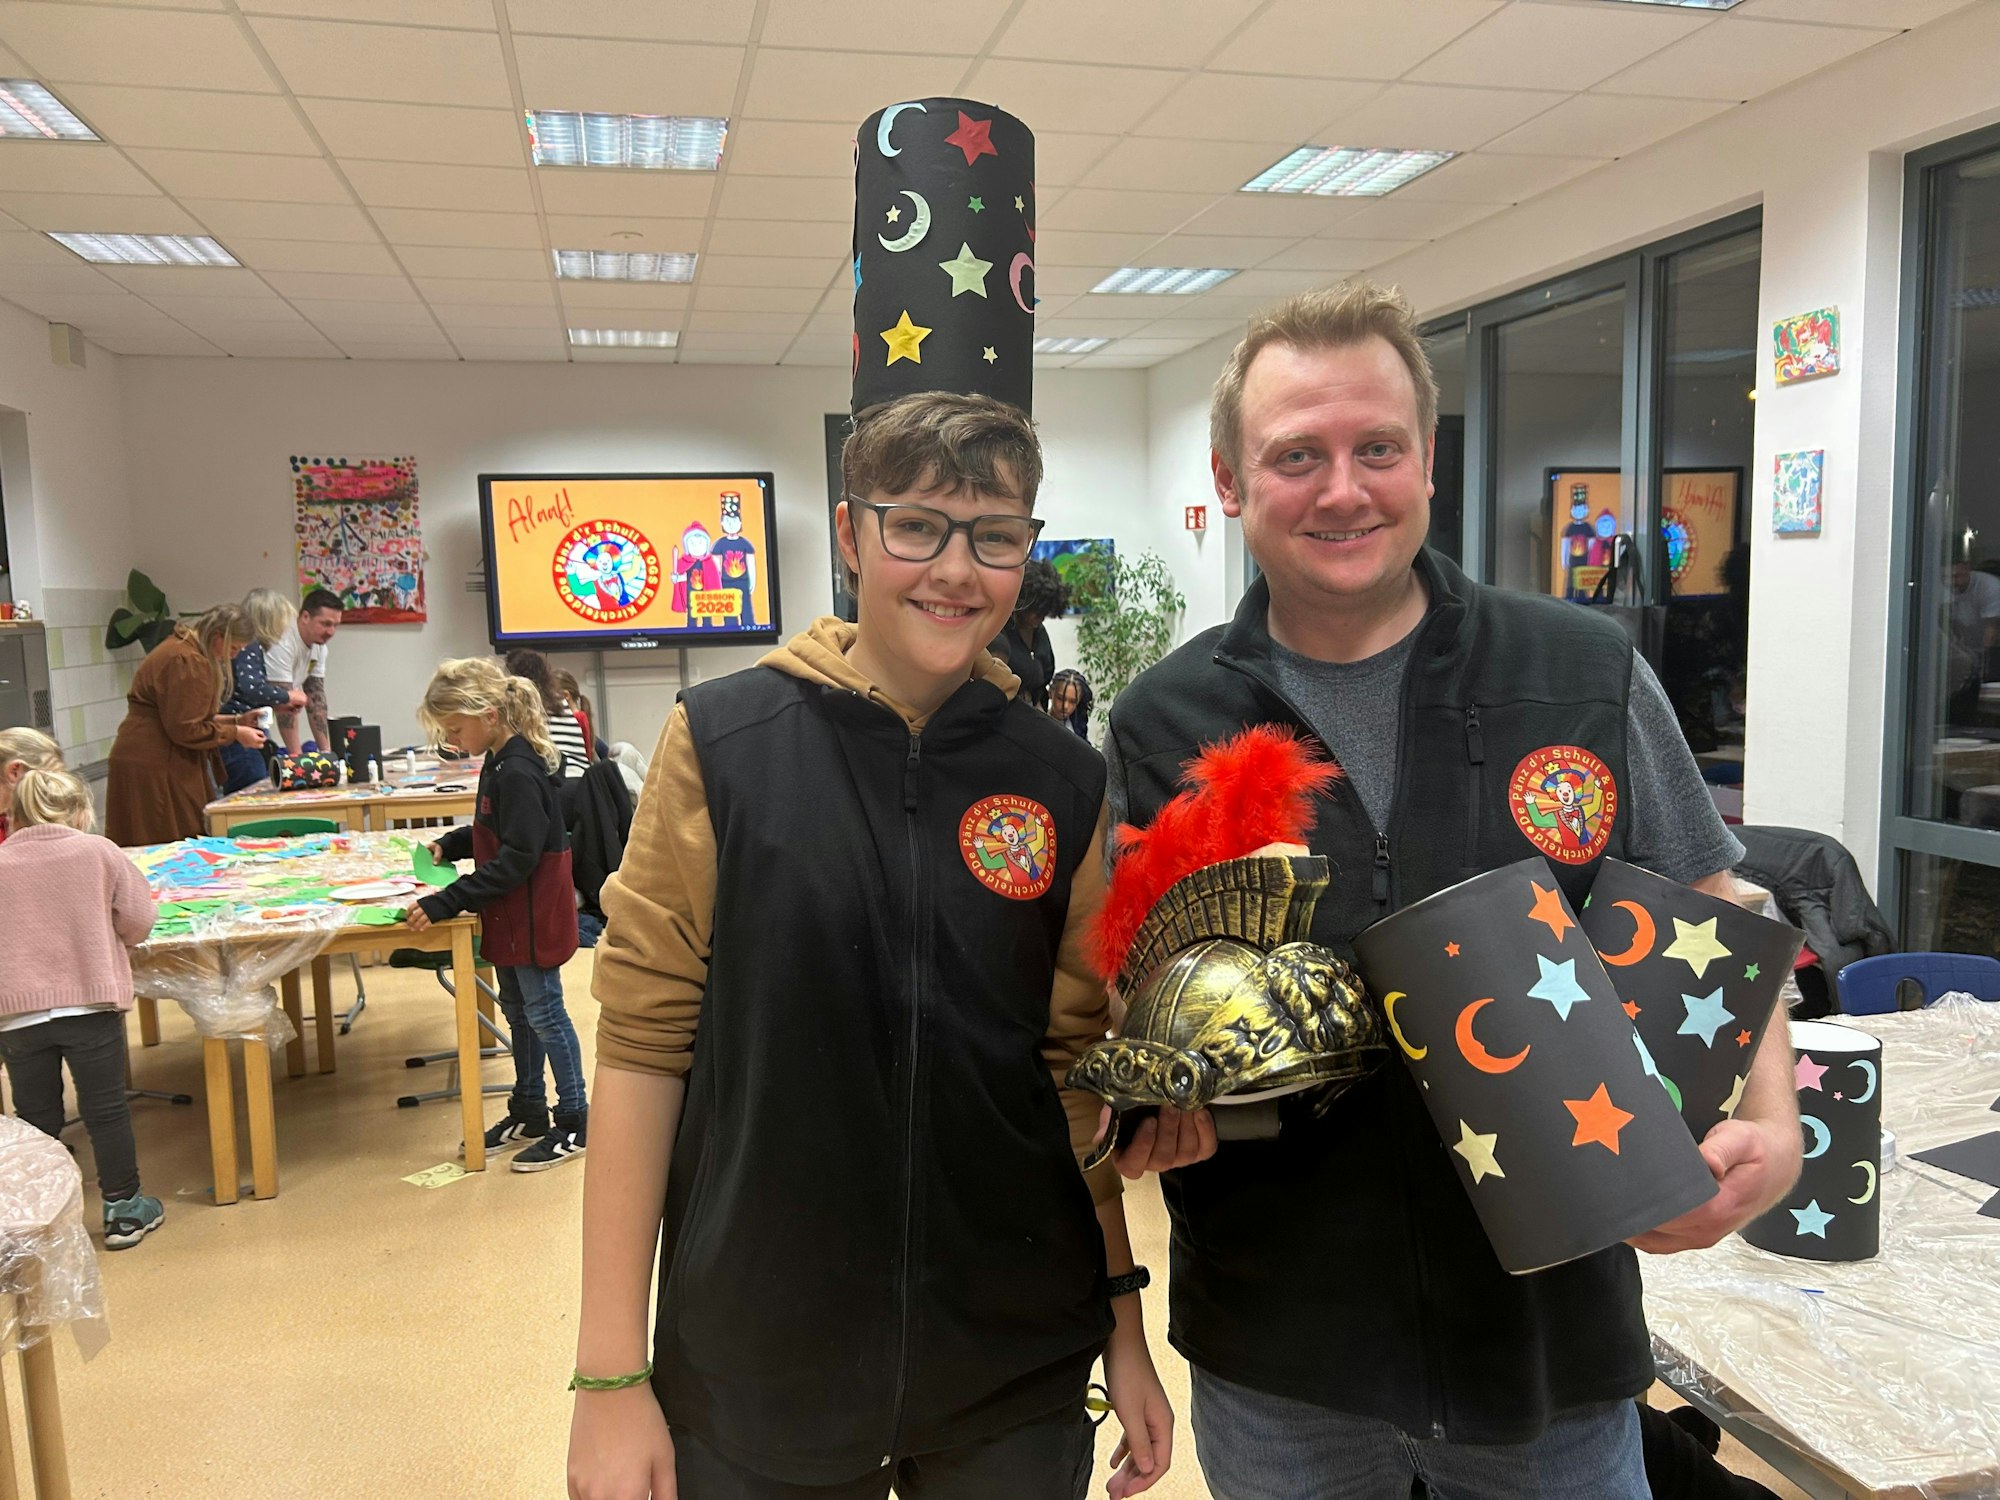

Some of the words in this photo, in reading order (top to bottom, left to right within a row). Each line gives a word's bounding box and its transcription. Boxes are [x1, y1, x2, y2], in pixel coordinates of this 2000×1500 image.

[508, 487, 574, 543] Alaaf!
[595, 521, 640, 543] Schull
[640, 542, 650, 552] &
[646, 555, 659, 584] OGS
[559, 576, 571, 595] De
[637, 587, 655, 606] Em
[695, 592, 735, 602] SESSION
[571, 600, 638, 622] Kirchfeld
[696, 601, 735, 614] 2026
[1529, 754, 1546, 768] d'r
[1552, 749, 1601, 772] Schull
[1513, 769, 1529, 801] Pänz
[1601, 775, 1610, 785] &
[974, 802, 989, 816] d'r
[993, 797, 1038, 812] Schull
[1604, 792, 1615, 824] OGS
[1040, 812, 1049, 822] &
[1517, 807, 1531, 826] De
[963, 817, 975, 846] Pänz
[1594, 828, 1607, 847] Em
[1047, 827, 1055, 857] OGS
[1533, 834, 1593, 859] Kirchfeld
[969, 852, 981, 869] De
[1044, 862, 1054, 880] Em
[985, 874, 1045, 896] Kirchfeld
